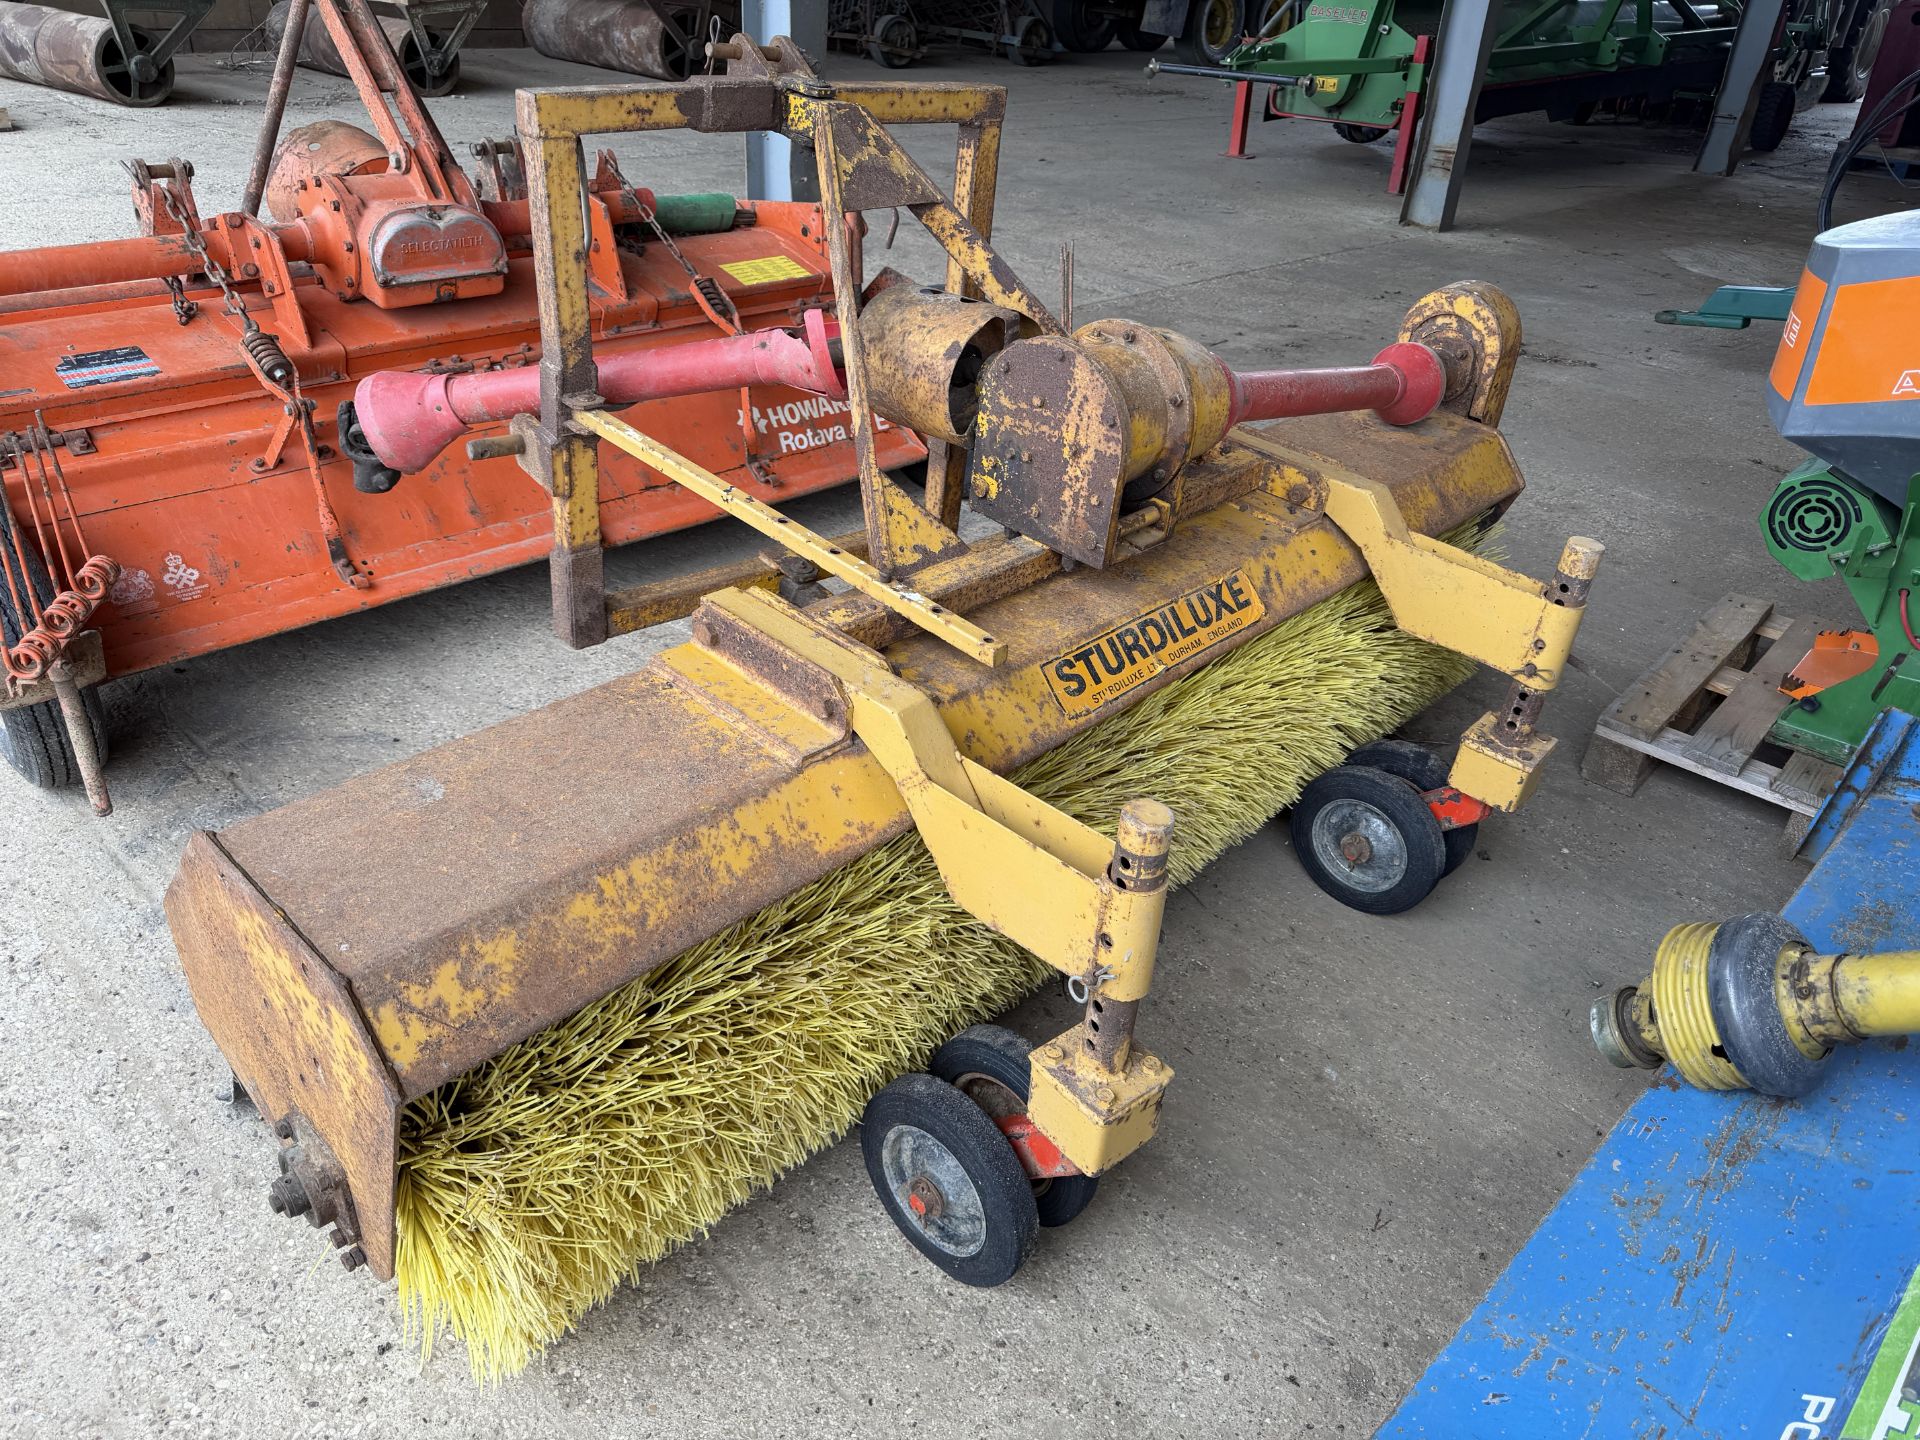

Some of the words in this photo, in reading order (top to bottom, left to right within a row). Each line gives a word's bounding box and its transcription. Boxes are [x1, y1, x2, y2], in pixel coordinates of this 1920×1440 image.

[400, 235, 483, 254] SELECTATILTH
[766, 397, 851, 428] HOWAR
[778, 424, 856, 454] Rotava
[1055, 575, 1251, 697] STURDILUXE
[1168, 637, 1205, 661] DURHAM,
[1207, 617, 1243, 641] ENGLAND
